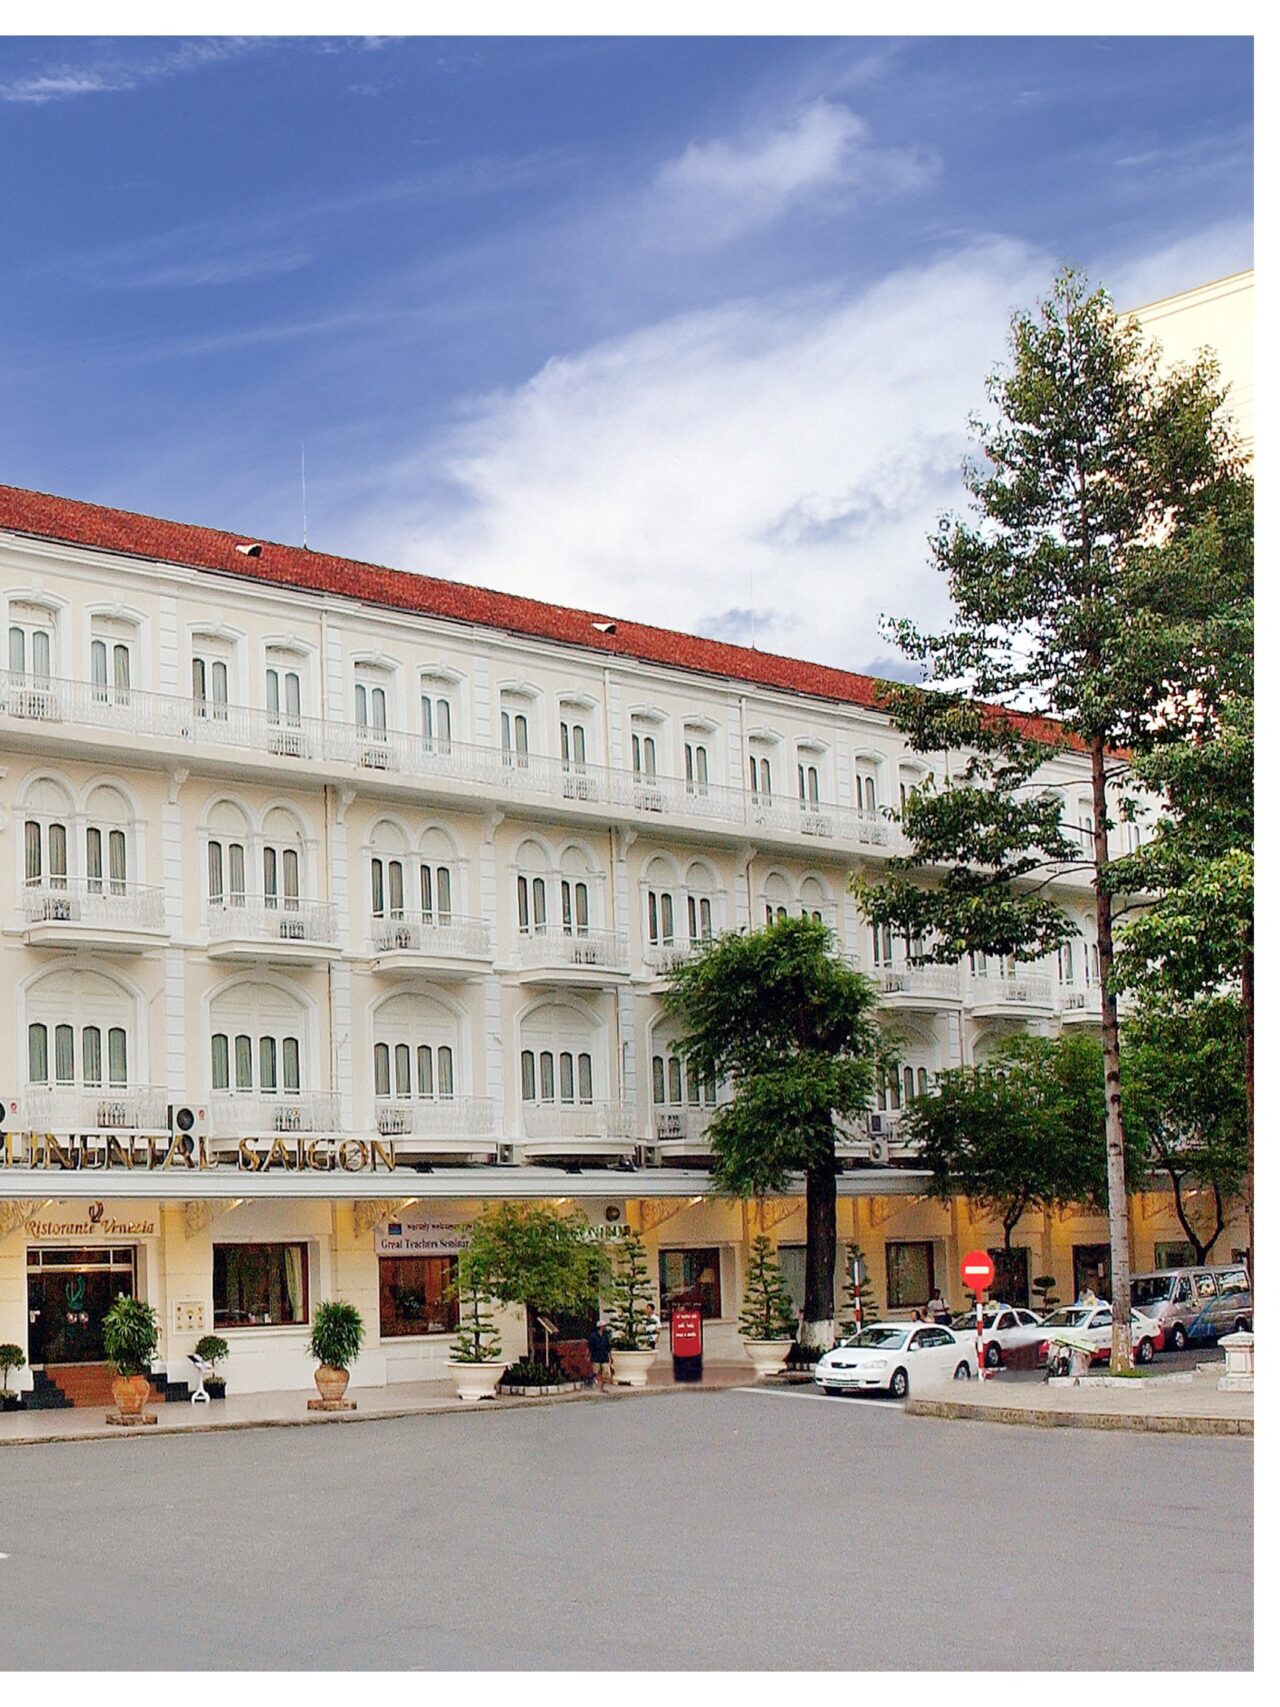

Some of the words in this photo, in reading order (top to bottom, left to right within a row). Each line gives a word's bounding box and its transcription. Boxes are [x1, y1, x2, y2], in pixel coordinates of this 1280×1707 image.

[238, 1136, 397, 1172] SAIGON
[25, 1220, 95, 1238] Ristorante
[101, 1218, 154, 1235] Venezia
[381, 1239, 403, 1250] Great
[405, 1239, 438, 1249] Teachers
